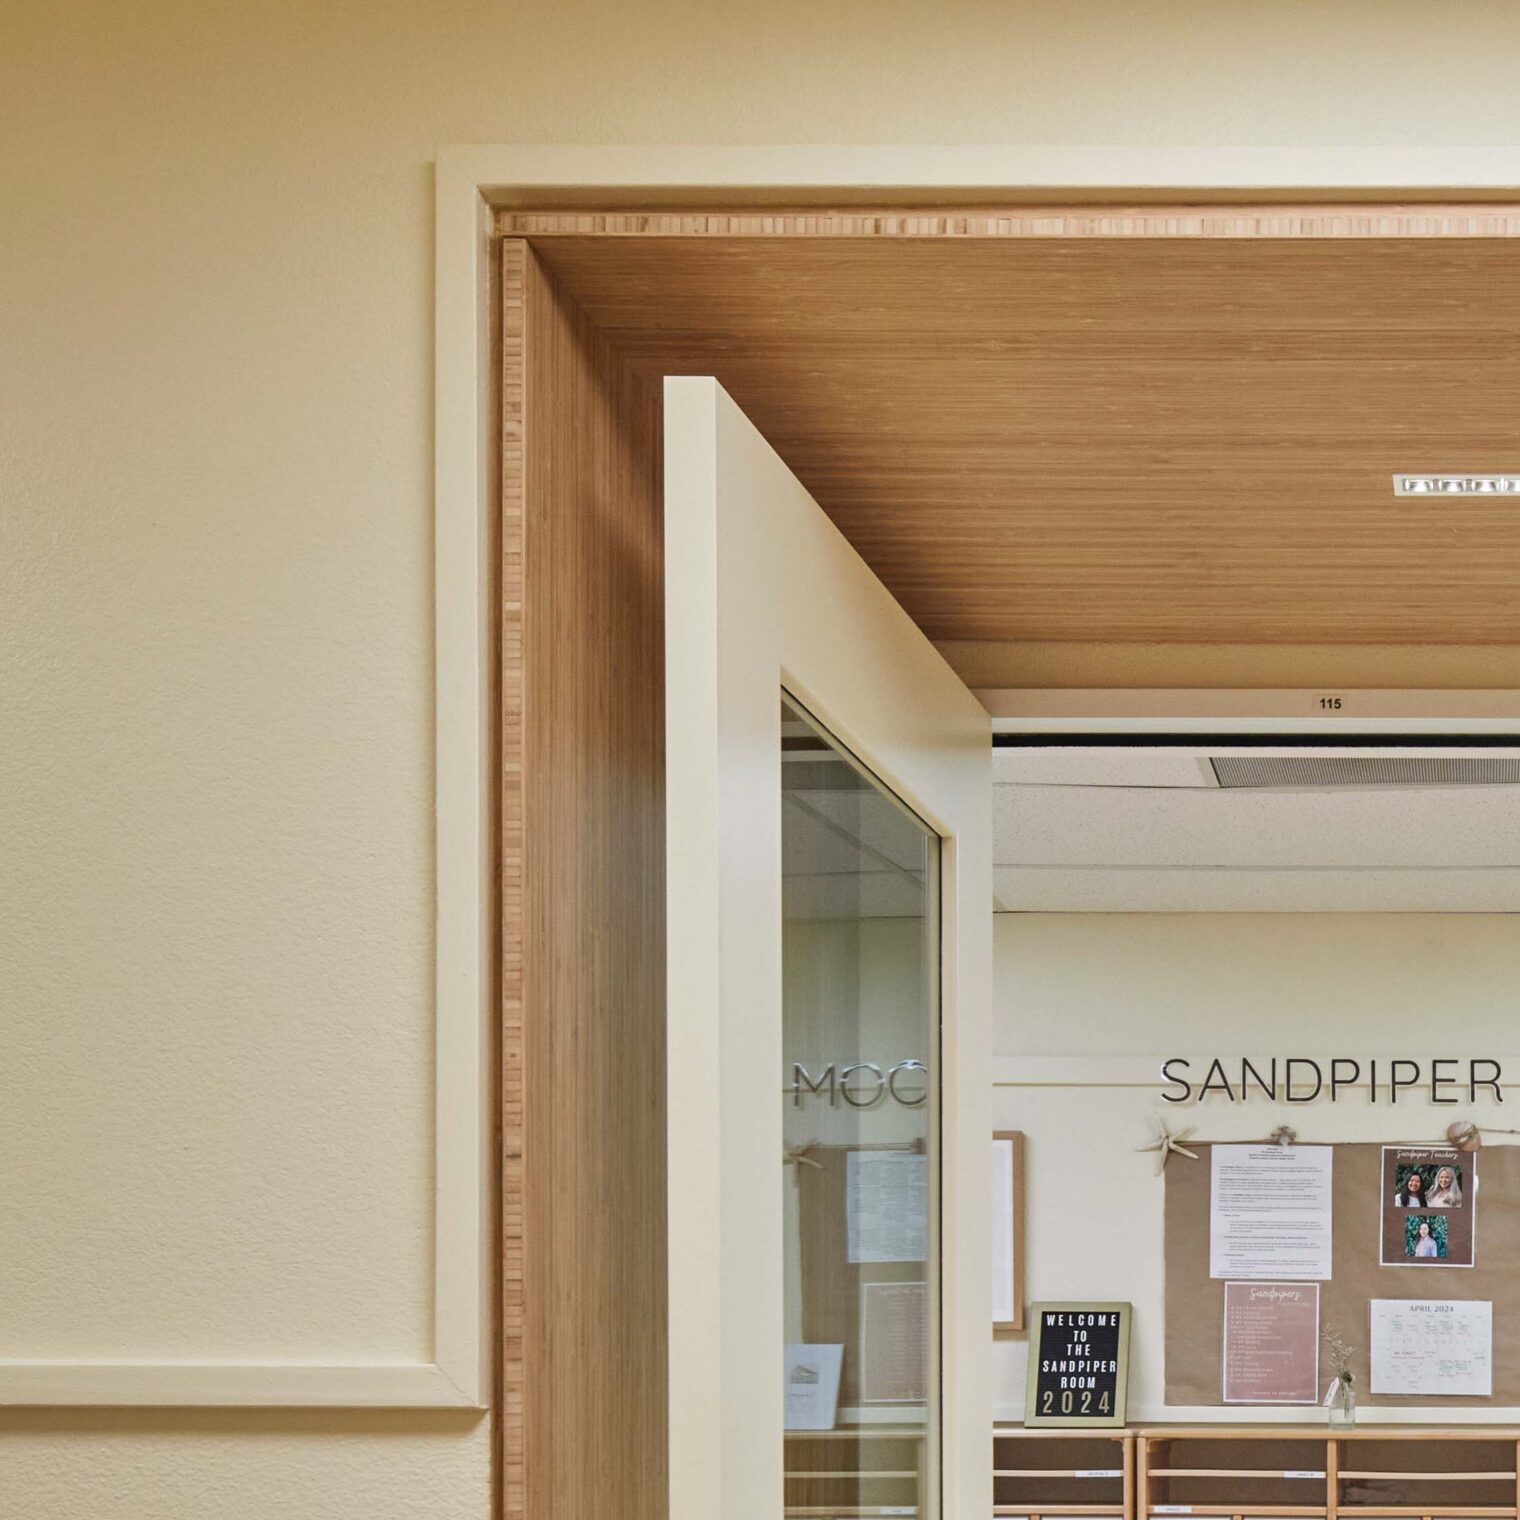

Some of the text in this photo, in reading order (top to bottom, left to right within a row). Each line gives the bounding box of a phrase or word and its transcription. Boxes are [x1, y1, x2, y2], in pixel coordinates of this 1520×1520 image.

[1319, 697, 1342, 710] 115
[1160, 1057, 1503, 1105] SANDPIPER
[1396, 1149, 1429, 1160] Sandpiper
[1249, 1287, 1303, 1301] Sandpipers
[1046, 1314, 1117, 1326] WELCOME
[1073, 1330, 1088, 1342] TO
[1066, 1344, 1091, 1356] THE
[1042, 1360, 1117, 1373] SANDPIPER
[1060, 1376, 1096, 1389] ROOM
[1042, 1390, 1110, 1414] 2024
